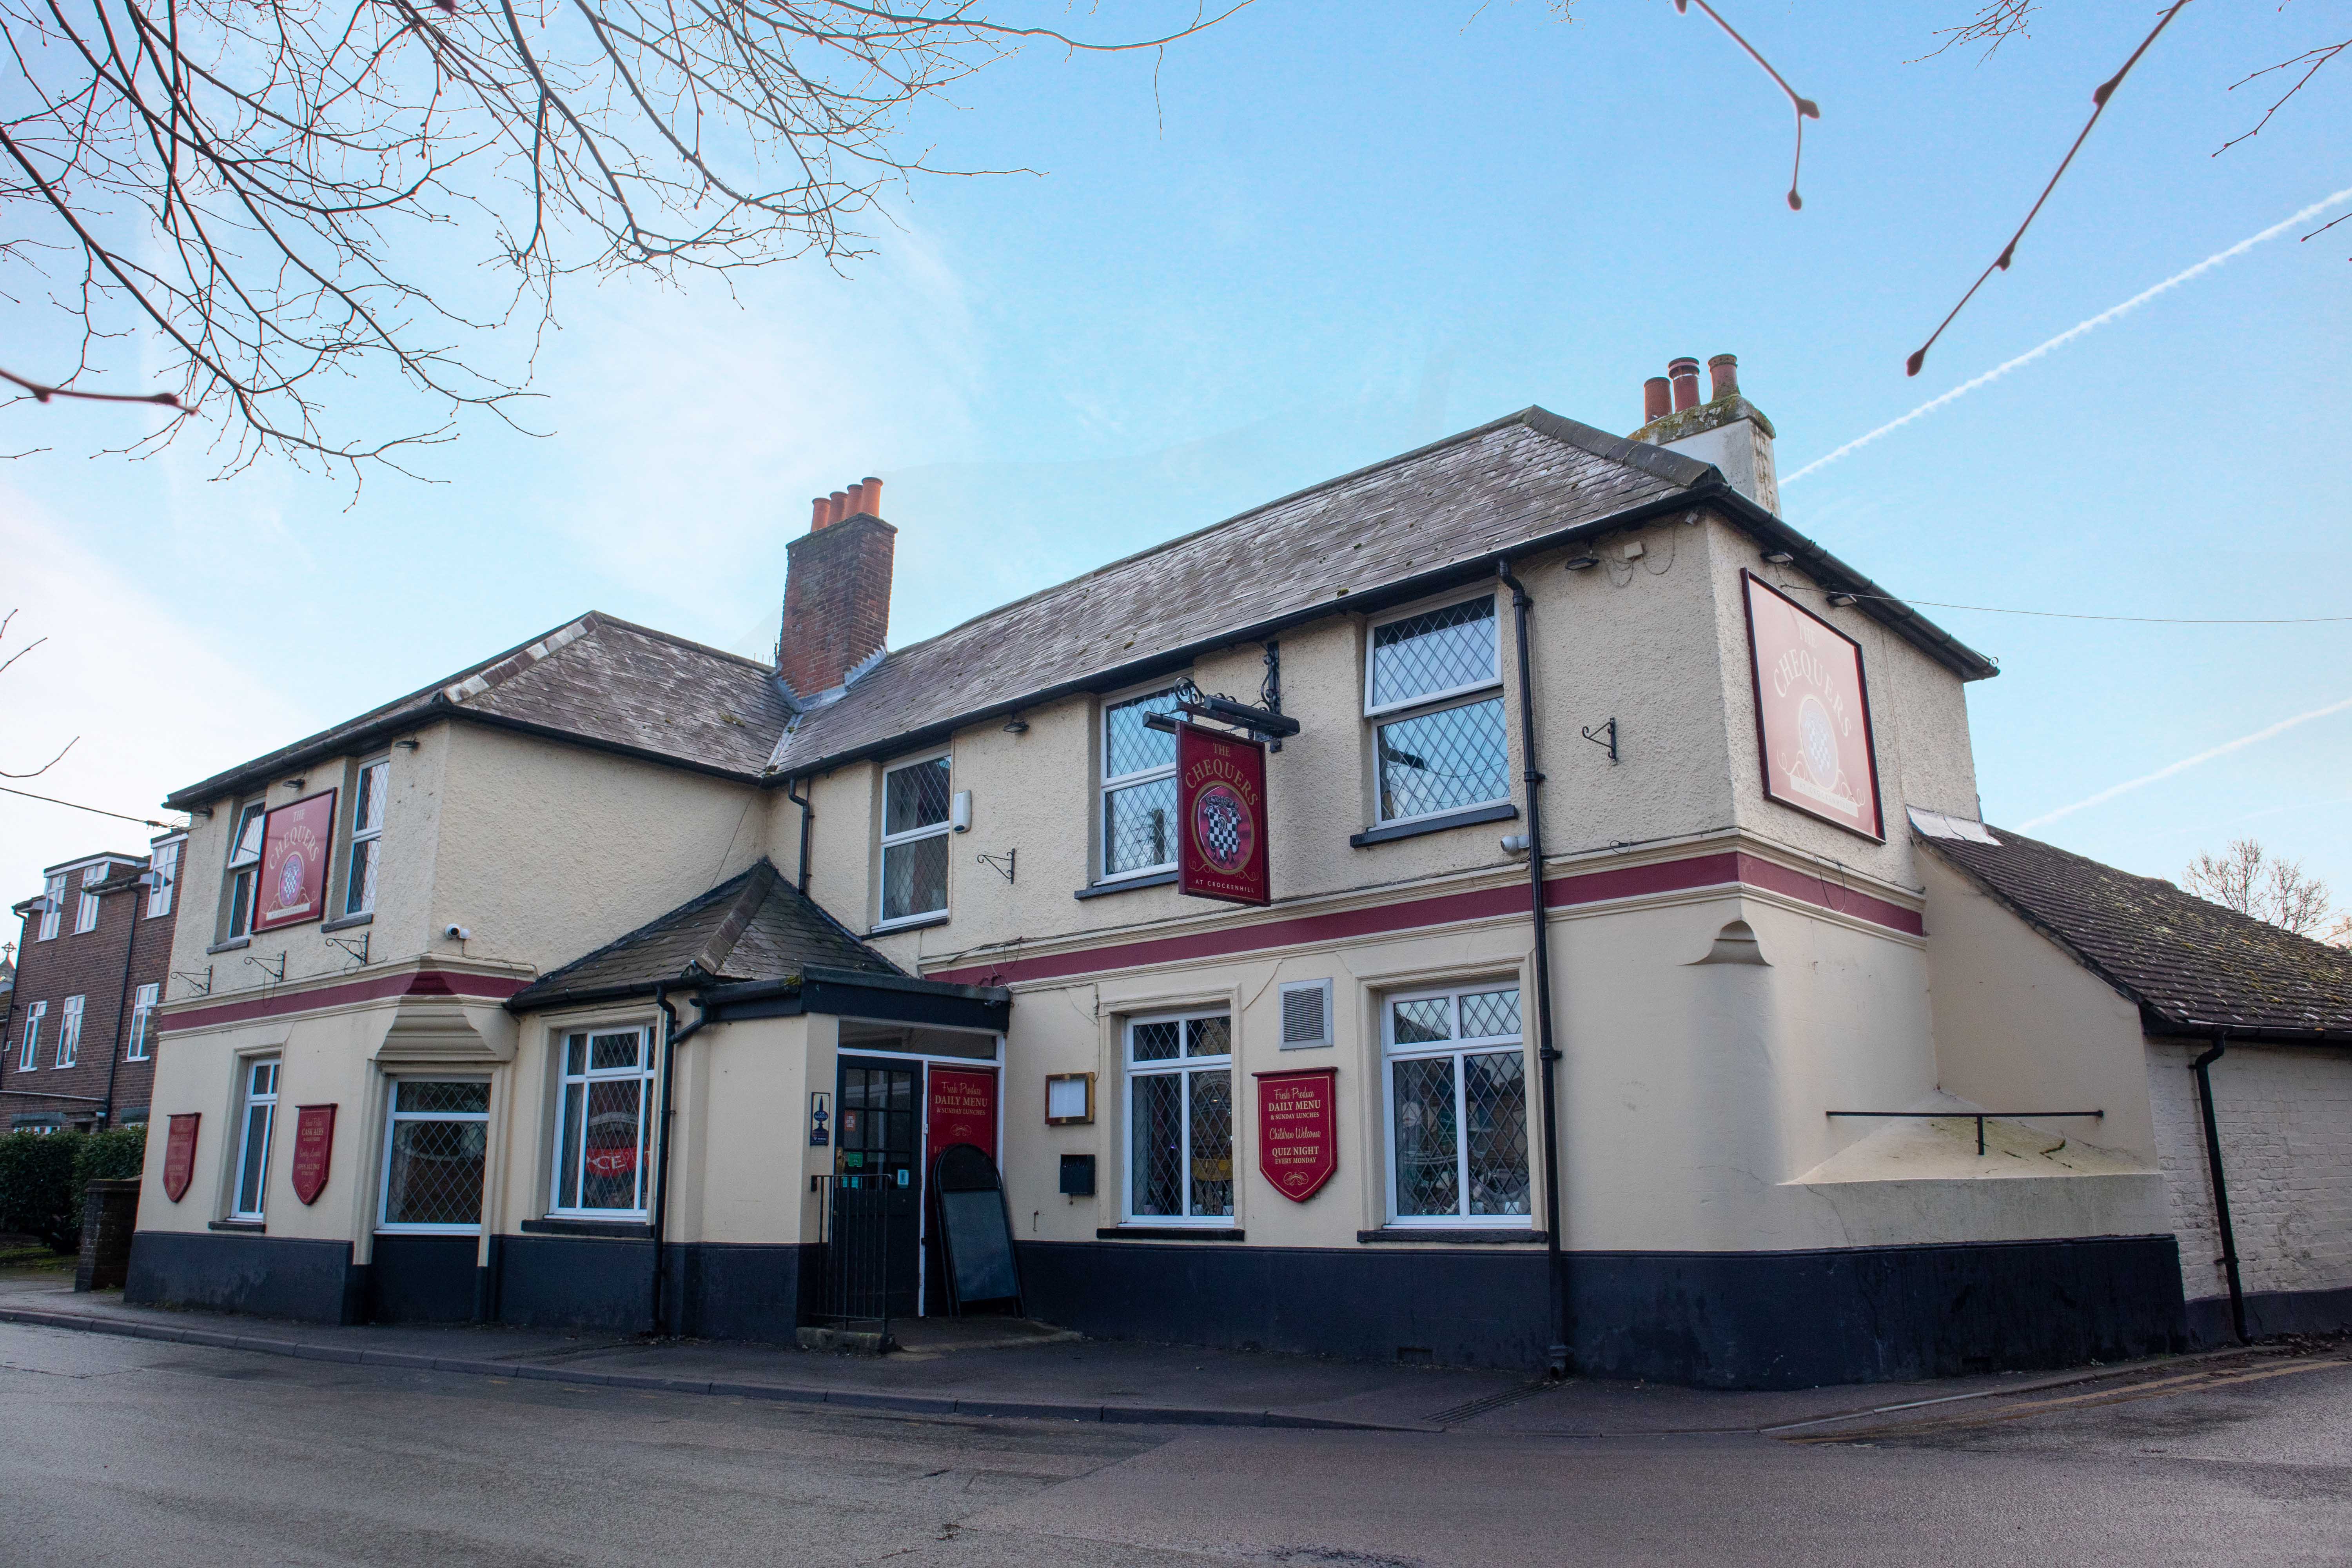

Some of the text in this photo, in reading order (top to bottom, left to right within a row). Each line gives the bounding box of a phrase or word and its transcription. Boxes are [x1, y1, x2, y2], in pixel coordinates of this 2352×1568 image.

[1797, 622, 1817, 648] THE
[1774, 649, 1851, 737] CHEQUERS
[1213, 743, 1230, 757] THE
[1185, 759, 1258, 806] CHEQUERS
[293, 809, 305, 822] THE
[269, 826, 319, 869] CHEQUERS
[1207, 881, 1254, 893] CROCKENHILL
[941, 1082, 982, 1095] Fresh Produce
[1274, 1087, 1314, 1100] Fresh Produce
[935, 1095, 988, 1107] DAILY MENU
[1269, 1100, 1321, 1112] DAILY MENU
[1270, 1127, 1321, 1140] Children Welcome
[1272, 1146, 1319, 1157] QUIZ NIGHT
